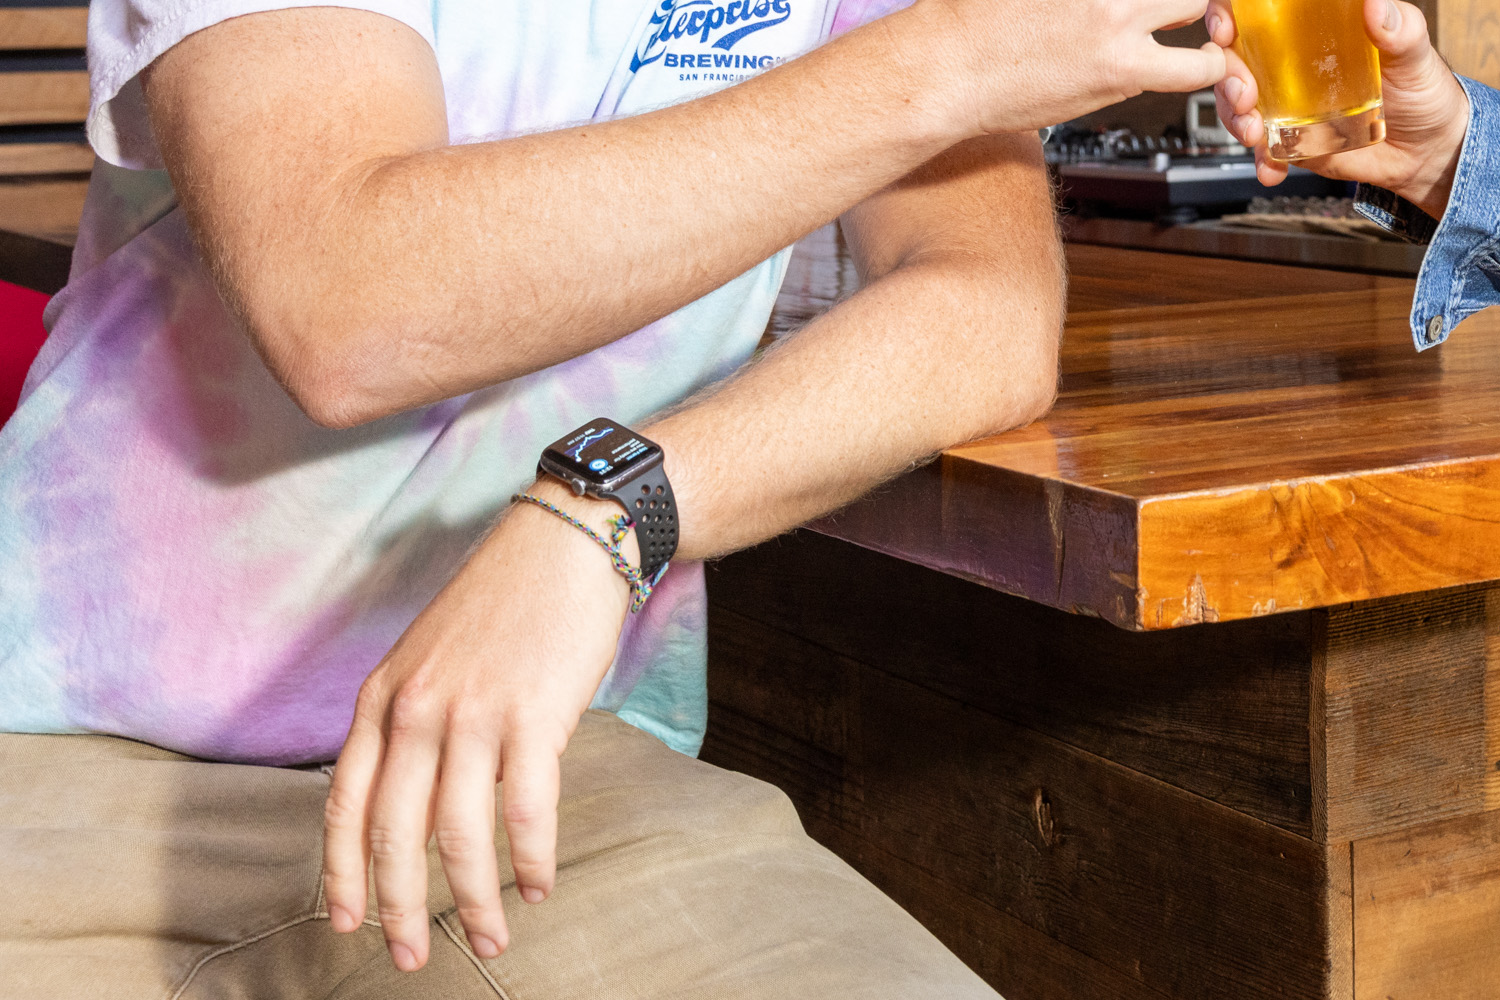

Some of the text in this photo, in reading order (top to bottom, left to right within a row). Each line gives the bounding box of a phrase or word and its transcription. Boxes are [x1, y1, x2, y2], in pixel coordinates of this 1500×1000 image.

[663, 52, 775, 70] BREWING
[679, 73, 754, 83] SAN FRANCISC
